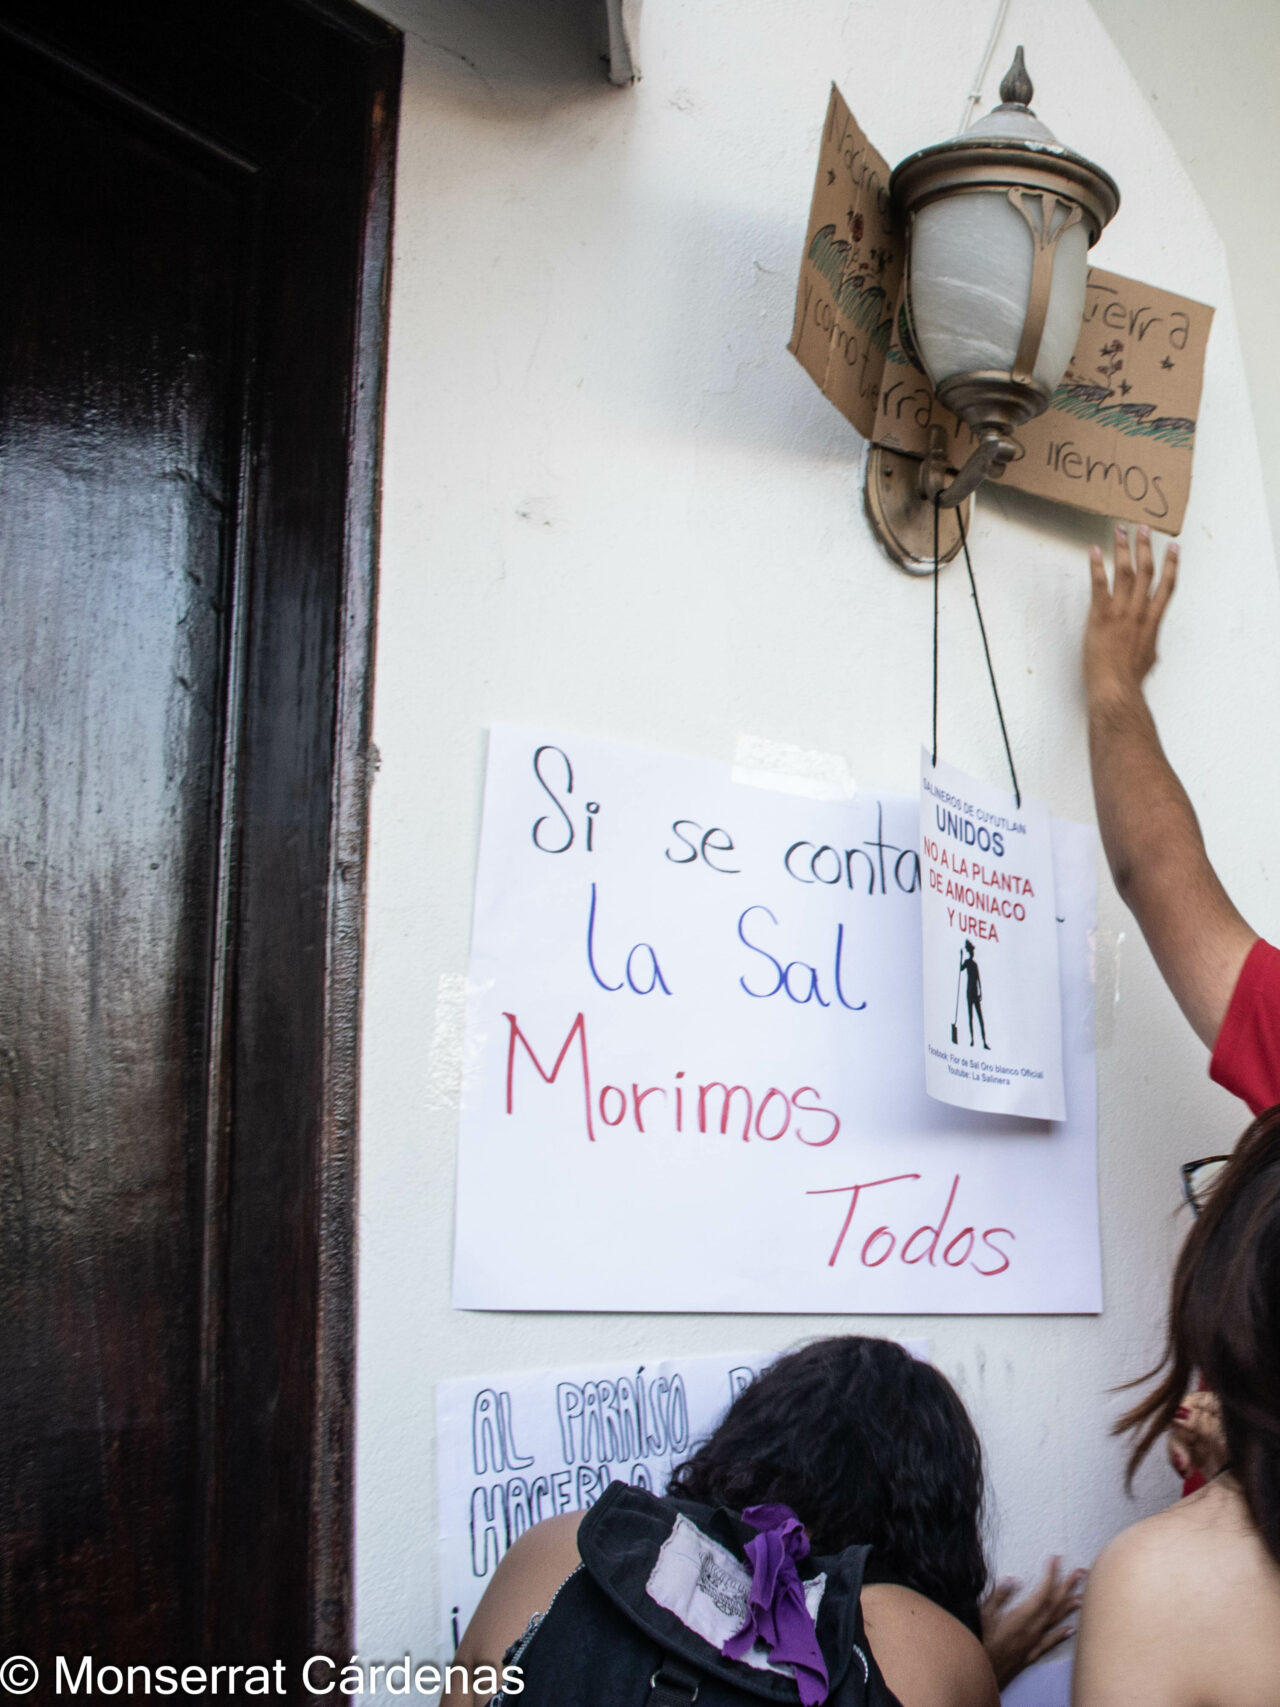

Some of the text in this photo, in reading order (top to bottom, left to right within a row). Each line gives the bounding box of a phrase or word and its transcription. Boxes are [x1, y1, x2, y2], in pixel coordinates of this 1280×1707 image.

[531, 745, 600, 853] Si
[665, 819, 741, 873] se
[923, 777, 962, 811] SALINEROS
[963, 802, 975, 818] DE
[935, 804, 1006, 858] UNIDOS
[924, 835, 1036, 898] NO A LA PLANTA
[929, 868, 1027, 922] DE AMONIACO
[947, 906, 1000, 943] Y UREA
[737, 905, 867, 1011] Sal
[501, 1011, 841, 1147] Morimos
[969, 1059, 980, 1070] Sal
[980, 1061, 994, 1073] Oro
[995, 1064, 1020, 1077] blanco
[972, 1071, 980, 1082] La
[806, 1173, 1016, 1277] Todos
[472, 1365, 690, 1475] AL PARAÍSO
